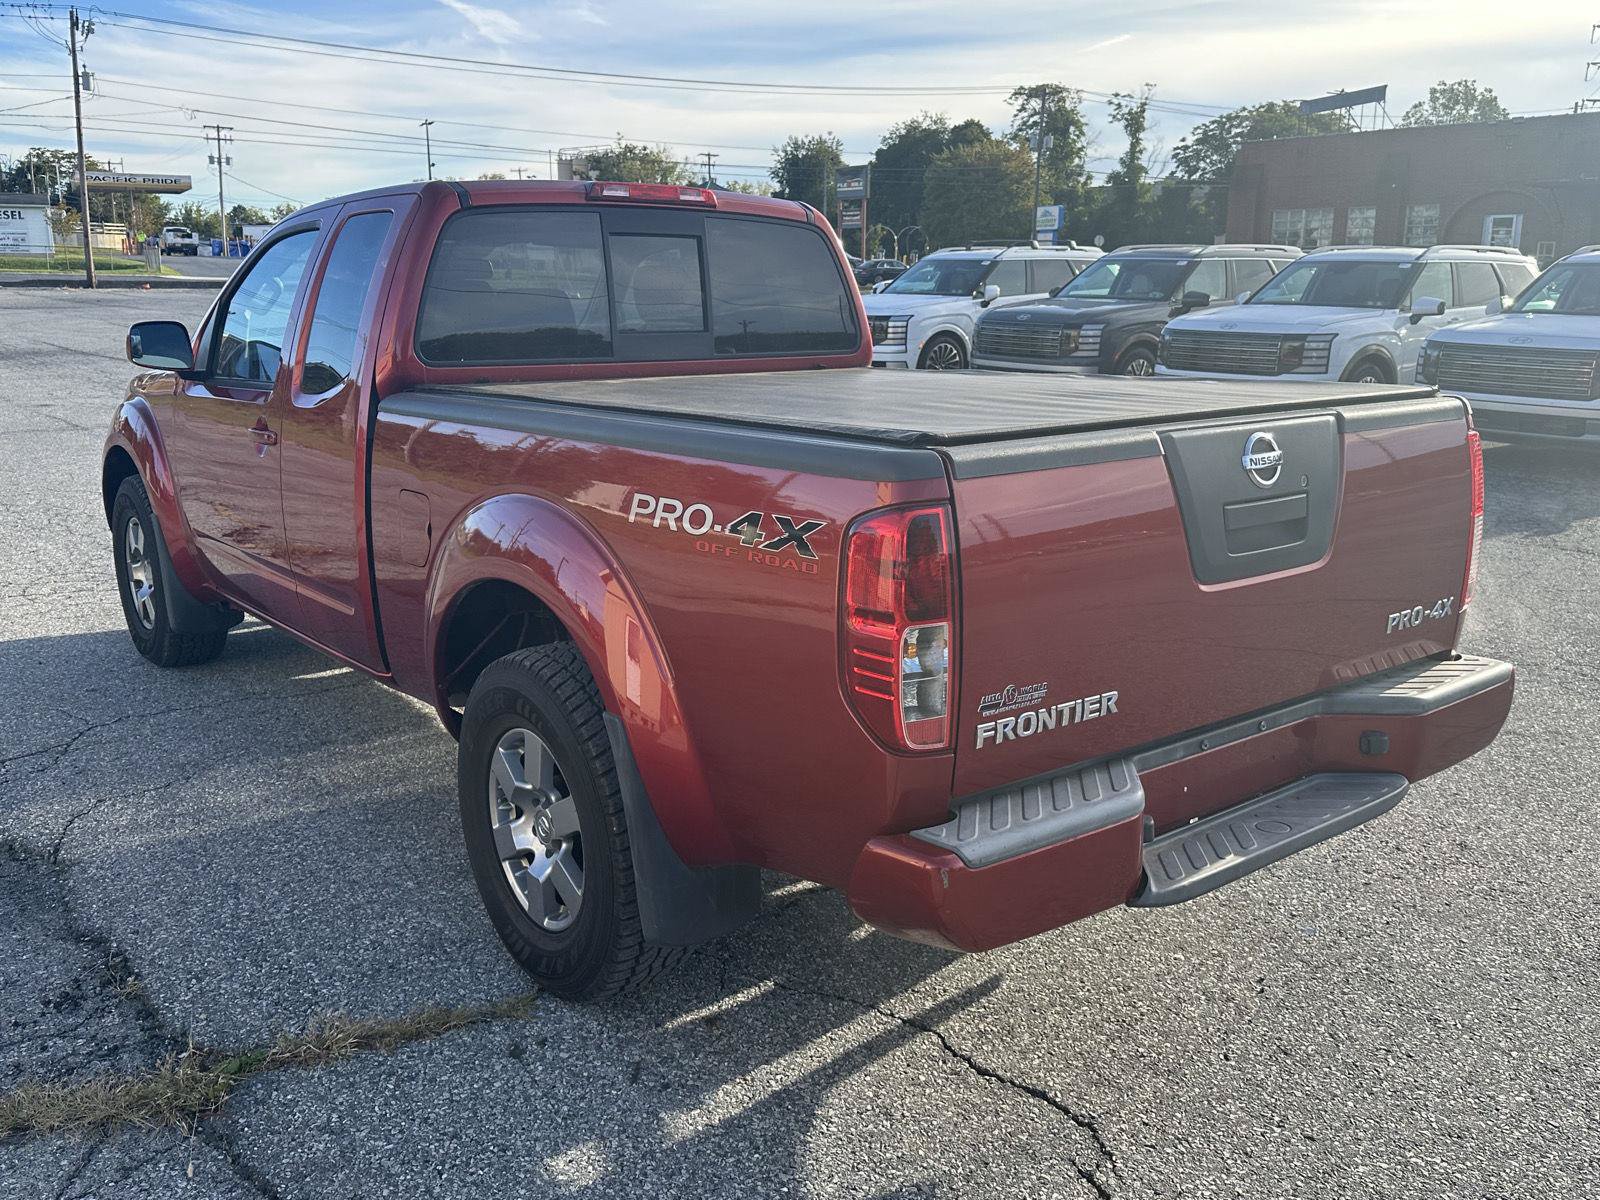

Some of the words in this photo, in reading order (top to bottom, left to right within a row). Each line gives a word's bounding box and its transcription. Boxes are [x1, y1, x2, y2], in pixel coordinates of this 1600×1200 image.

[86, 175, 138, 183] PACIFIC
[142, 177, 182, 185] PRIDE
[695, 540, 740, 557] OFF
[748, 551, 819, 575] ROAD
[1386, 596, 1454, 634] PRO-4X
[975, 691, 1119, 749] FRONTIER
